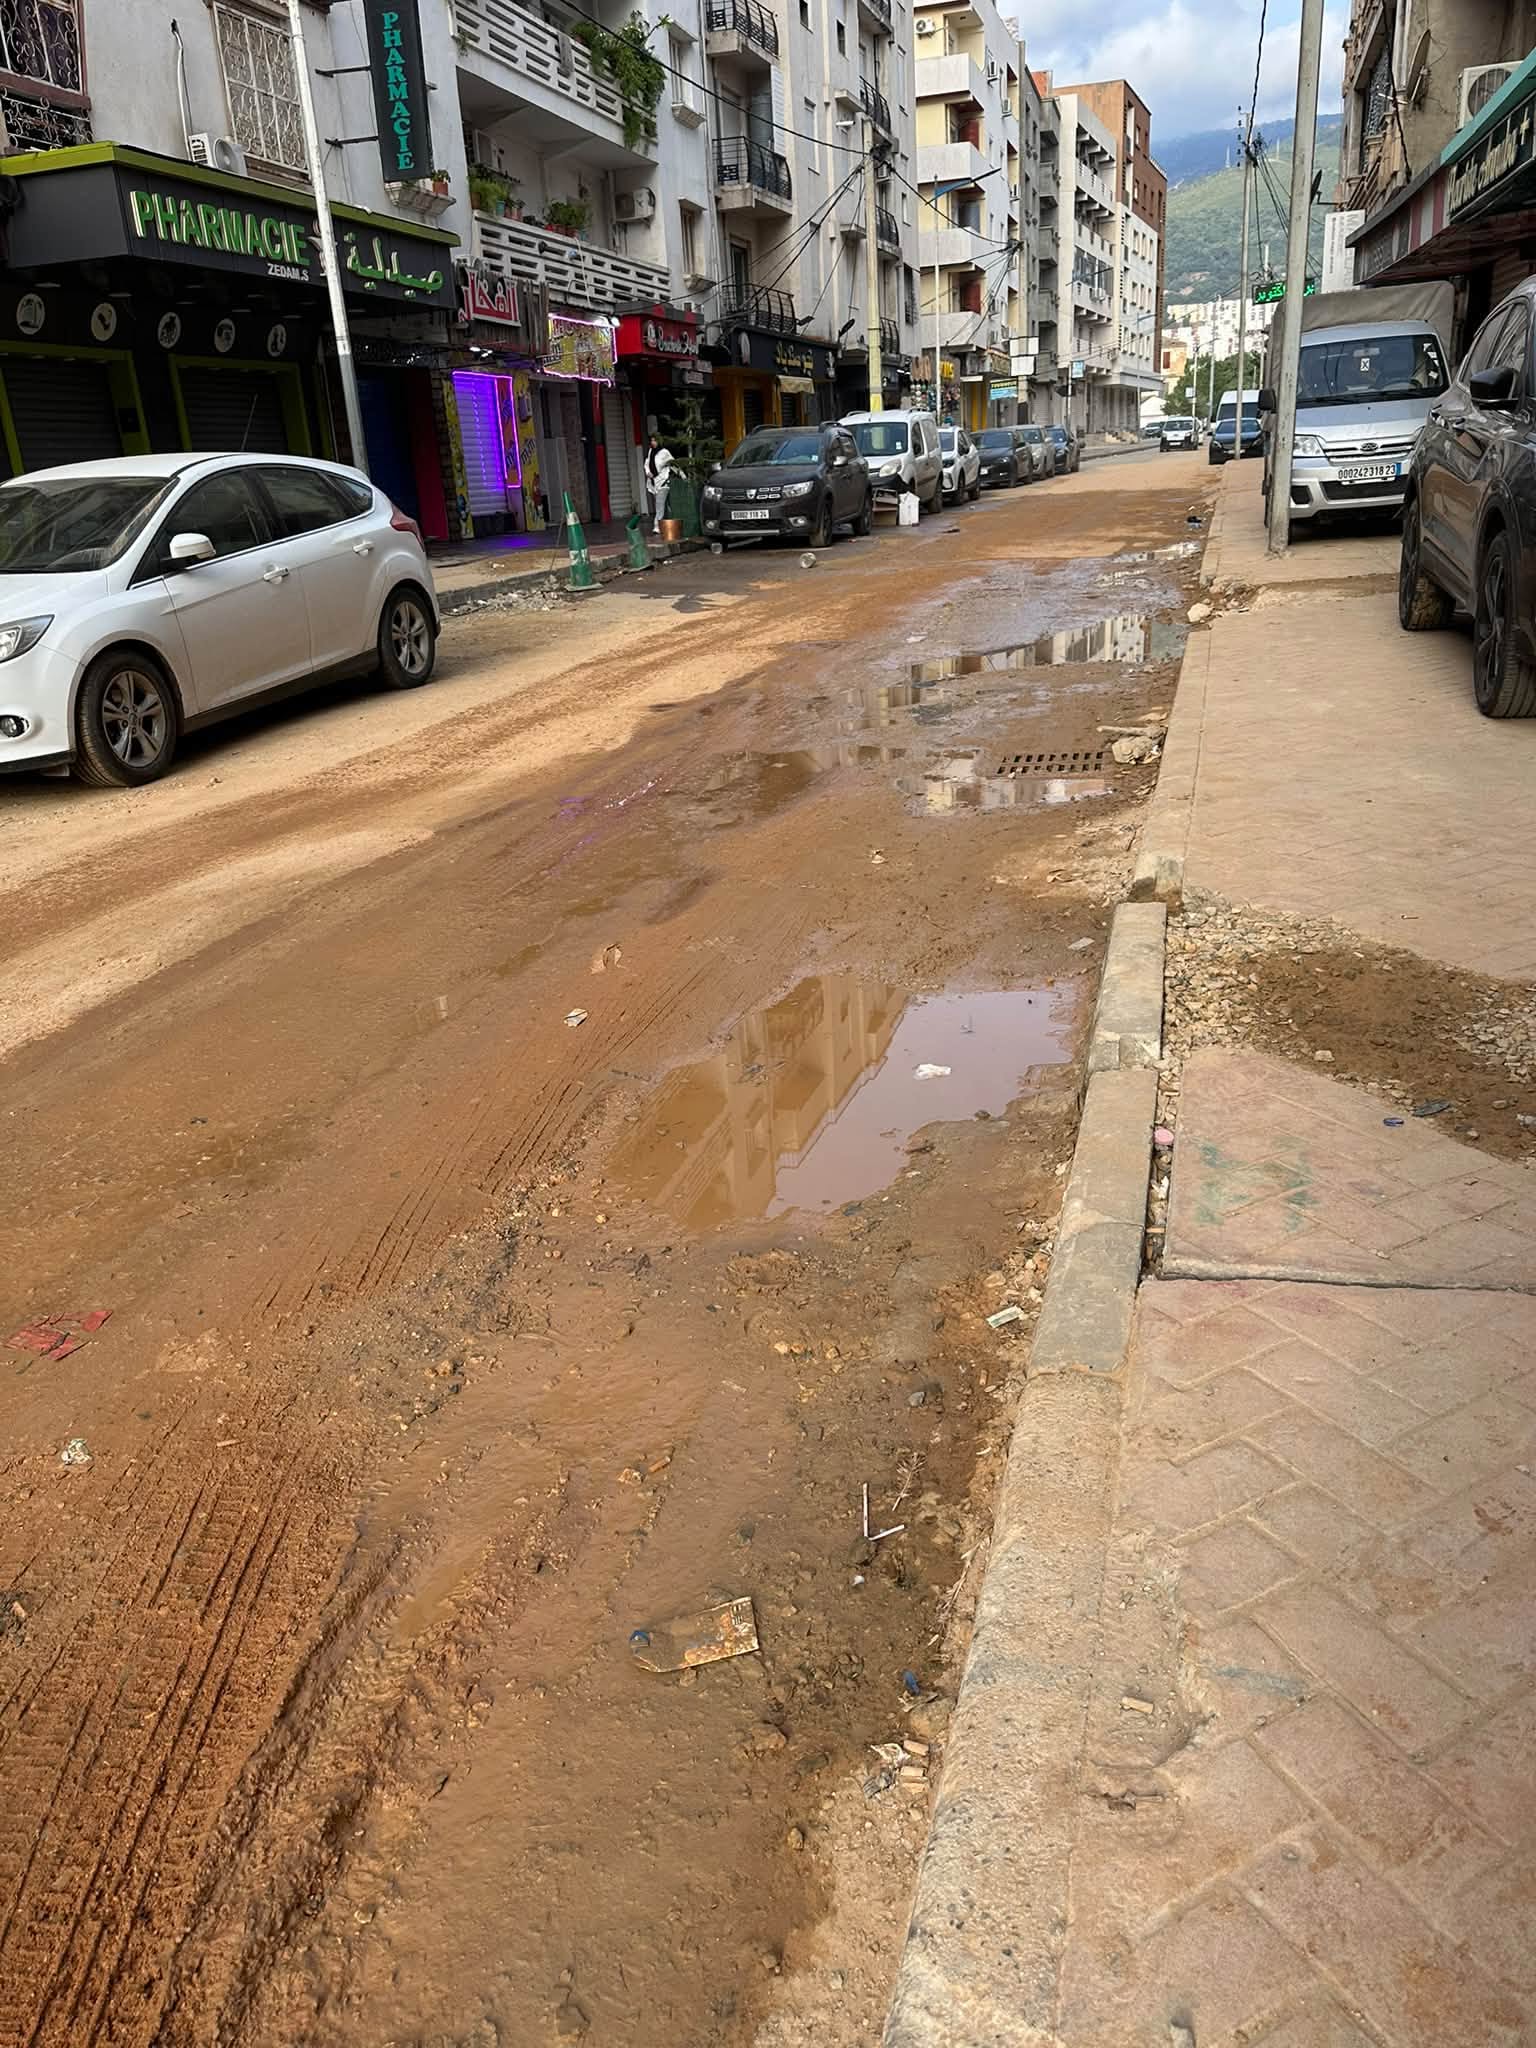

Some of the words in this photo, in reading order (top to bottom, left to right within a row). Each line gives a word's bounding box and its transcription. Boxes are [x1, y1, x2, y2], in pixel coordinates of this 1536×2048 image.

[382, 12, 415, 170] PHARMACIE
[130, 191, 310, 265] PHARMACIE
[267, 263, 309, 281] ZEDAM.S
[344, 233, 443, 298] صيدلية
